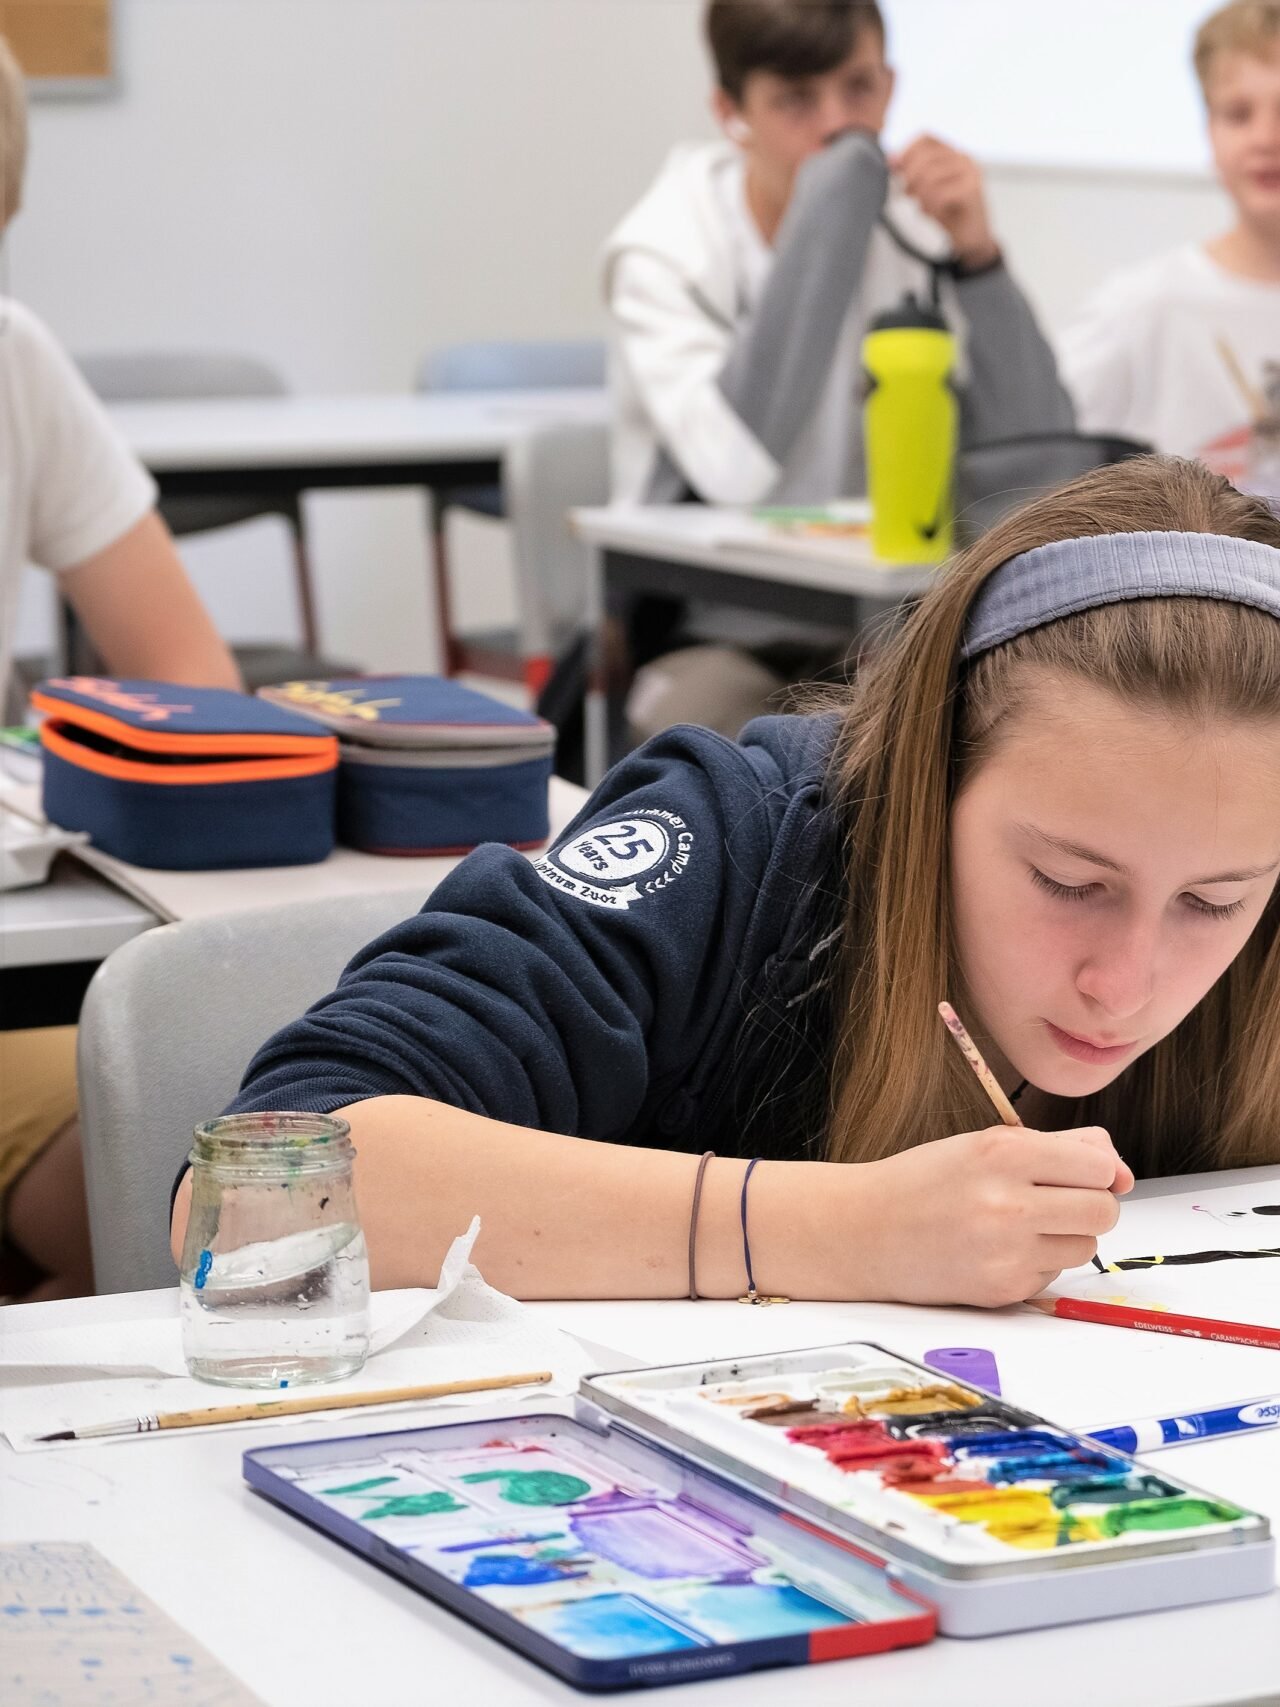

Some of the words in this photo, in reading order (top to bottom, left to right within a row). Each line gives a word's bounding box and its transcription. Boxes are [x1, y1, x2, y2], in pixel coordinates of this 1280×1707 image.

[573, 840, 609, 871] Years
[593, 824, 655, 860] 25
[623, 808, 687, 828] ummer
[670, 832, 693, 874] Camp
[1133, 1321, 1174, 1333] EDELWEISS
